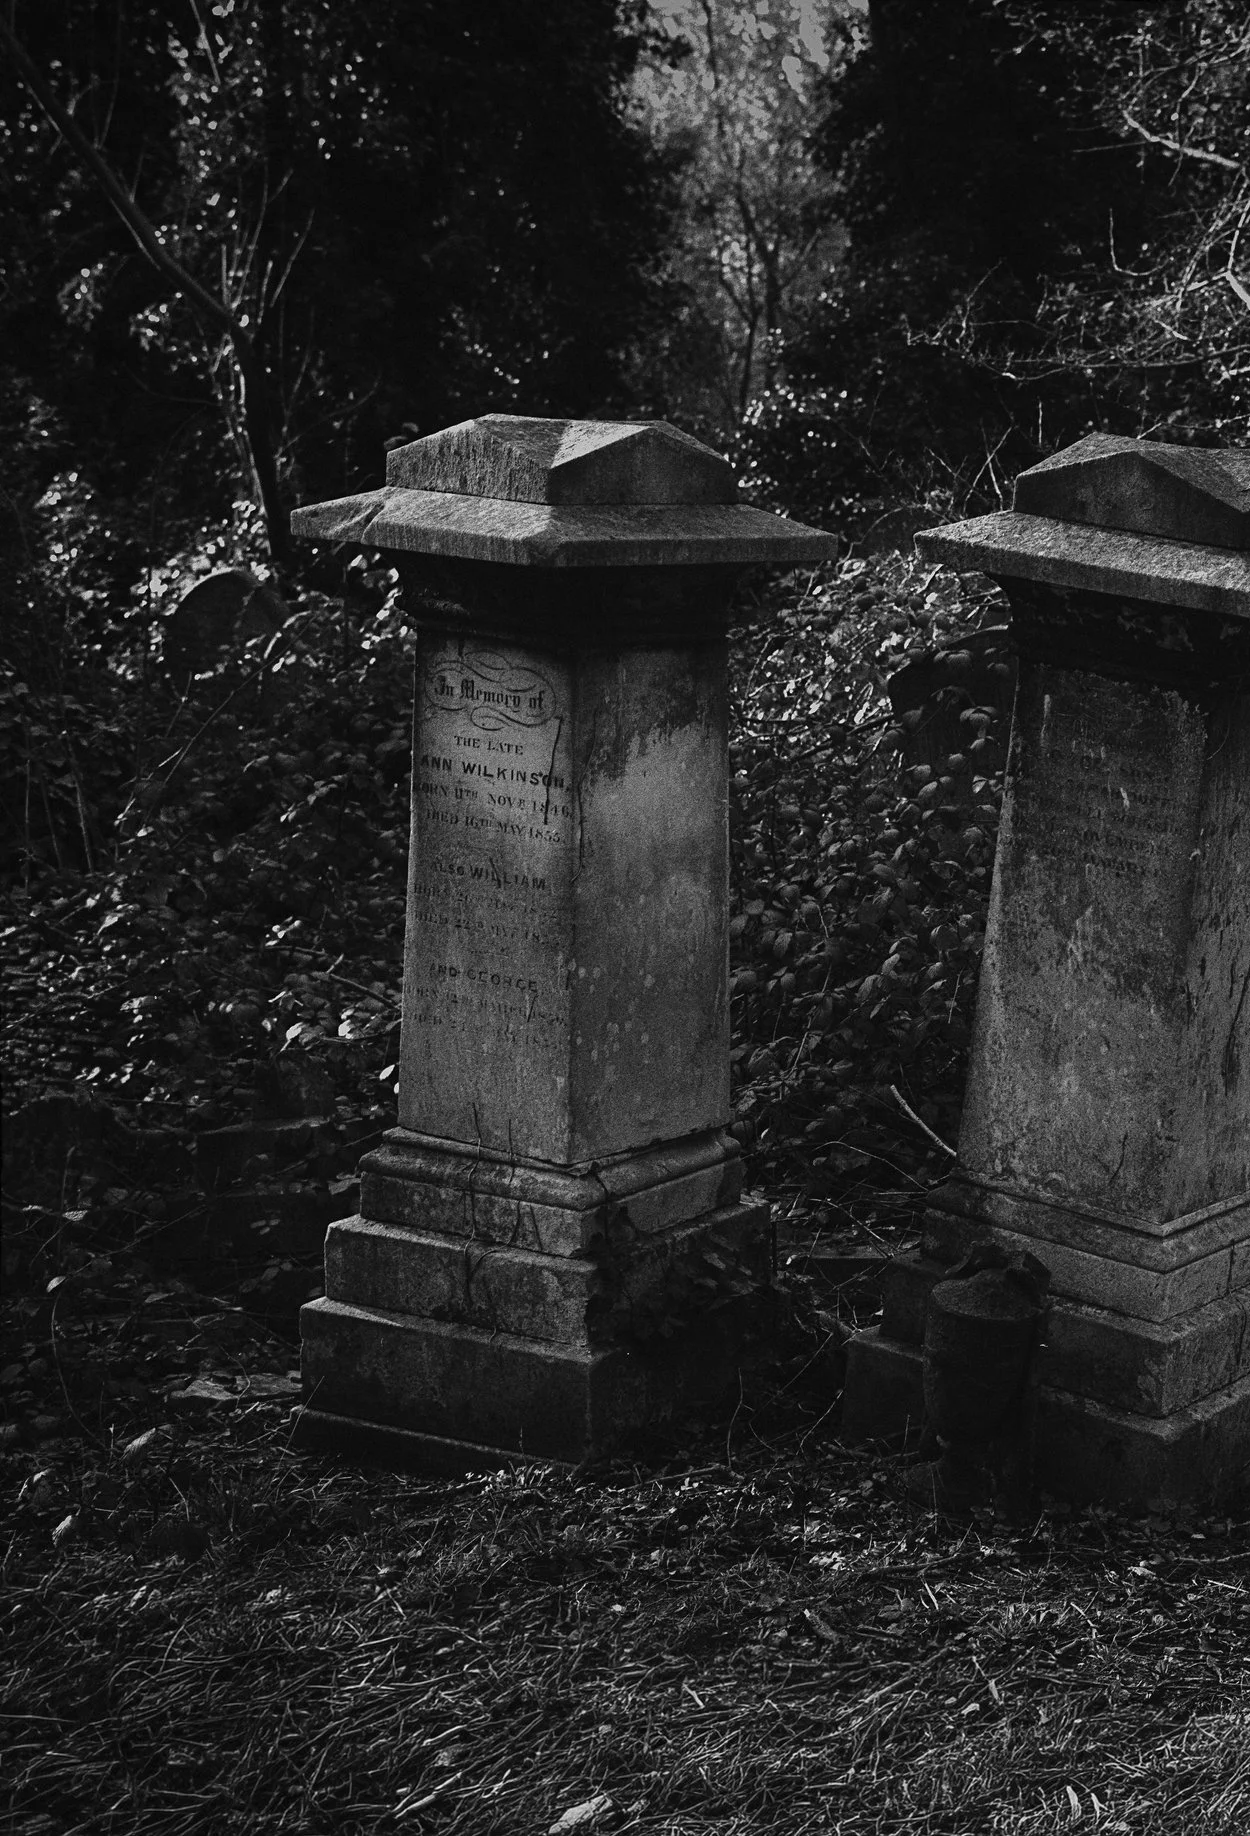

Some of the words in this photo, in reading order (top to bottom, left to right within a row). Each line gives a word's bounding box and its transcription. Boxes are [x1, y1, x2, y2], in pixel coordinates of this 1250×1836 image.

[435, 674, 454, 697] In
[460, 678, 521, 713] Memory
[528, 690, 546, 711] of
[454, 736, 480, 749] THE
[487, 741, 523, 756] LATE
[421, 755, 452, 771] ANN
[497, 821, 526, 836] MAY
[469, 864, 546, 891] WILLIAM
[467, 969, 538, 994] GEORGE
